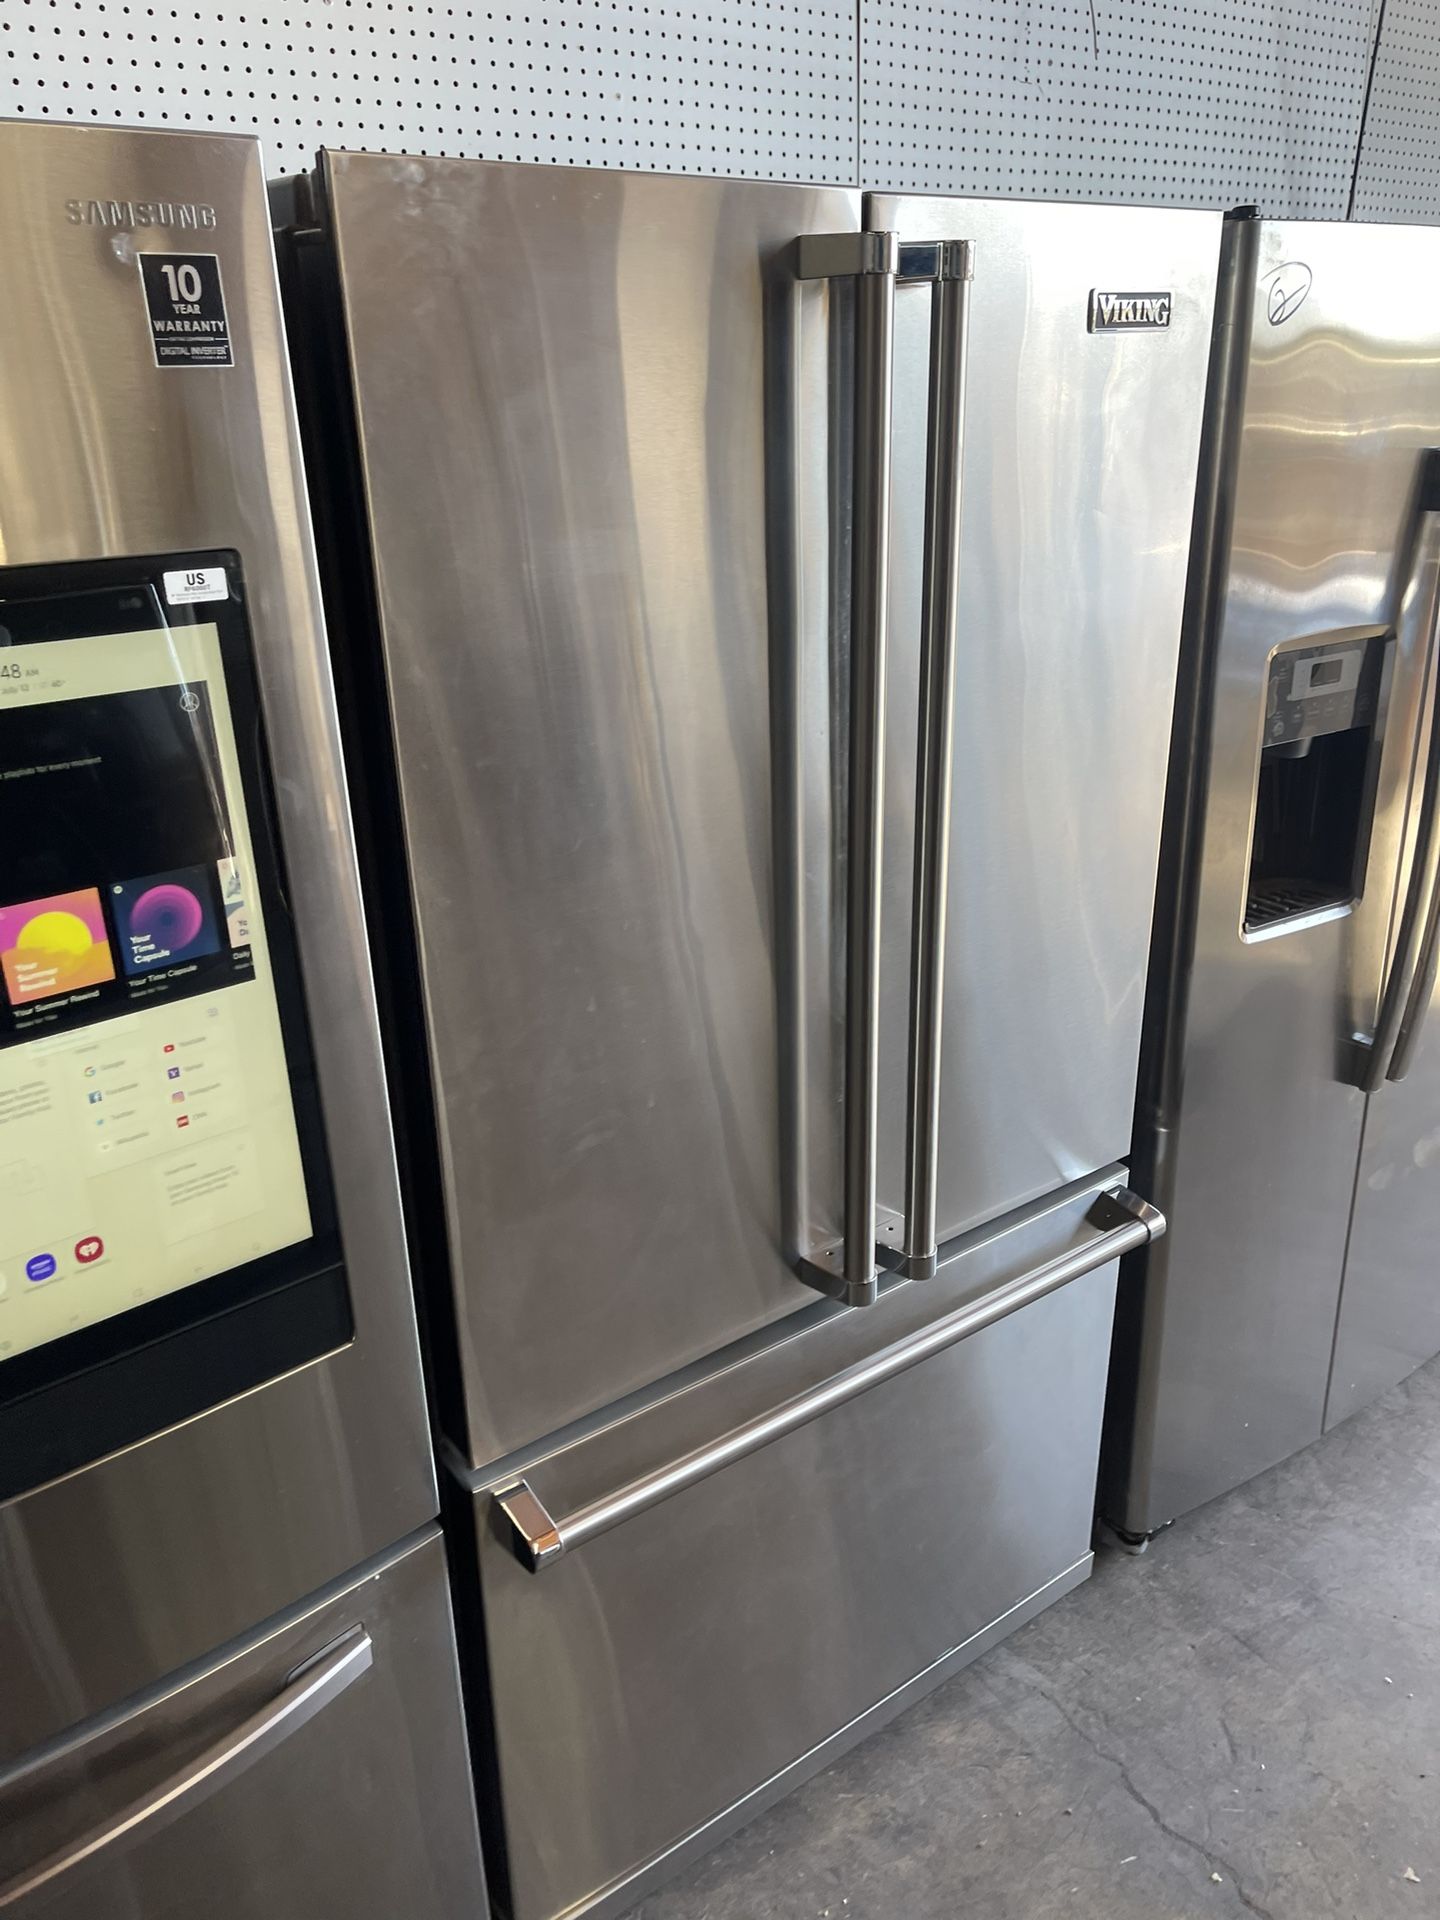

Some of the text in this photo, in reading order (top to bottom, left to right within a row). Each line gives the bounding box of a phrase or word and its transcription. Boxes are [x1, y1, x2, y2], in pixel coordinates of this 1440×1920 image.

[65, 199, 217, 231] SAMSUNG
[161, 264, 202, 302] 10
[172, 303, 202, 315] YEAR
[153, 320, 225, 332] WARRANTY
[186, 572, 206, 586] US
